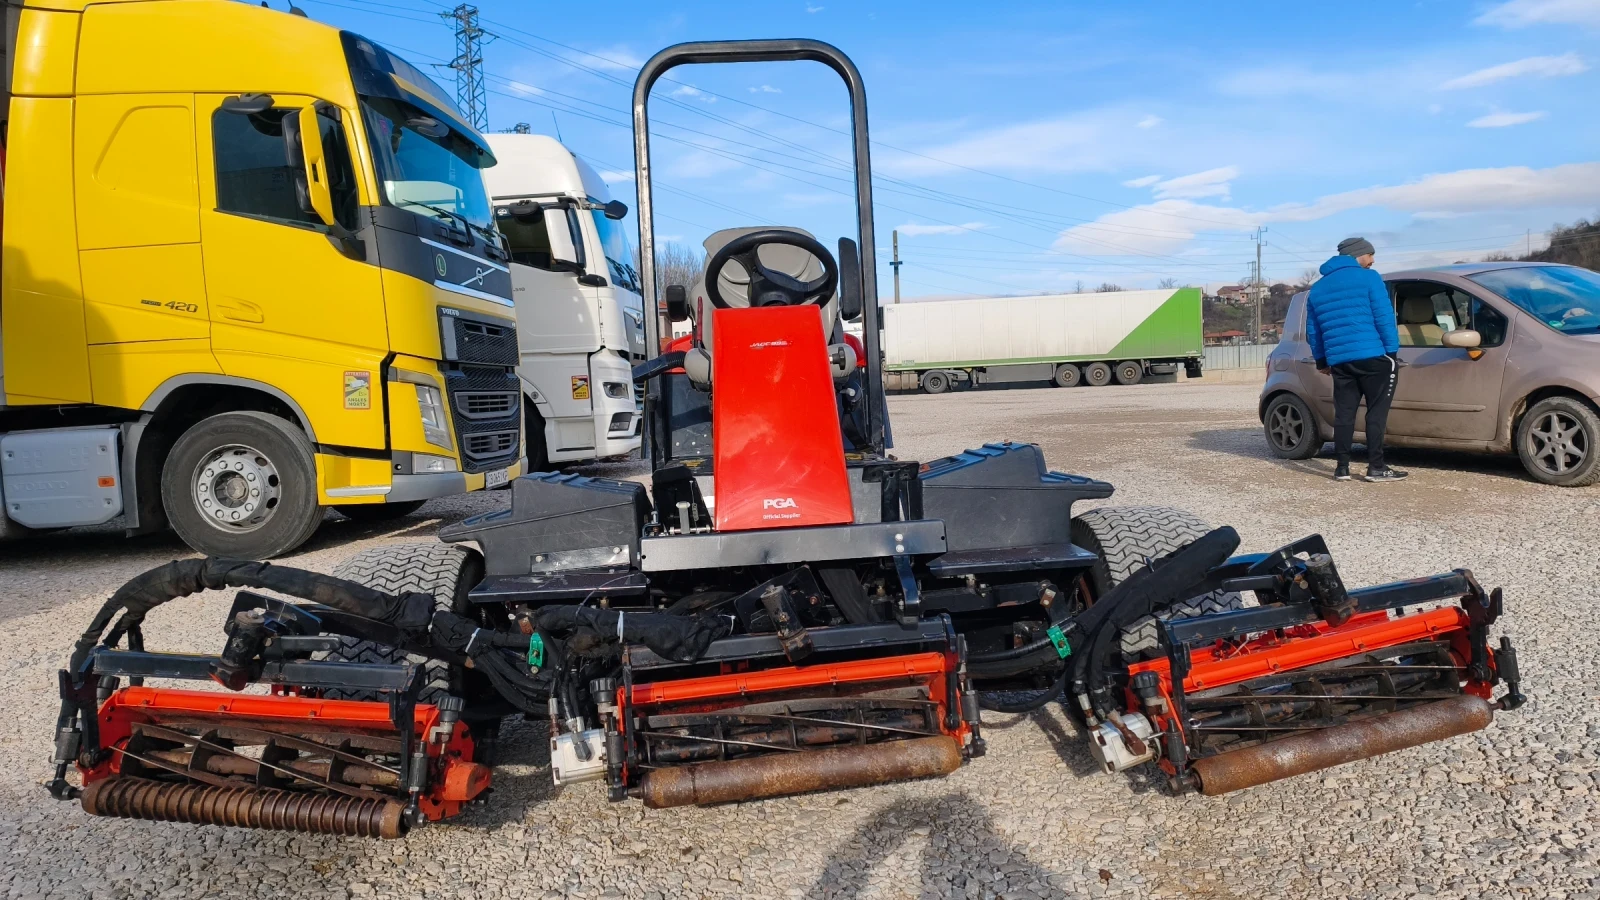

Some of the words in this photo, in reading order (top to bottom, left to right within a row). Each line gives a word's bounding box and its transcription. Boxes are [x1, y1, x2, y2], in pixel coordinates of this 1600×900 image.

[164, 301, 198, 313] 420
[441, 307, 459, 316] VOLVO
[763, 498, 797, 509] PGA
